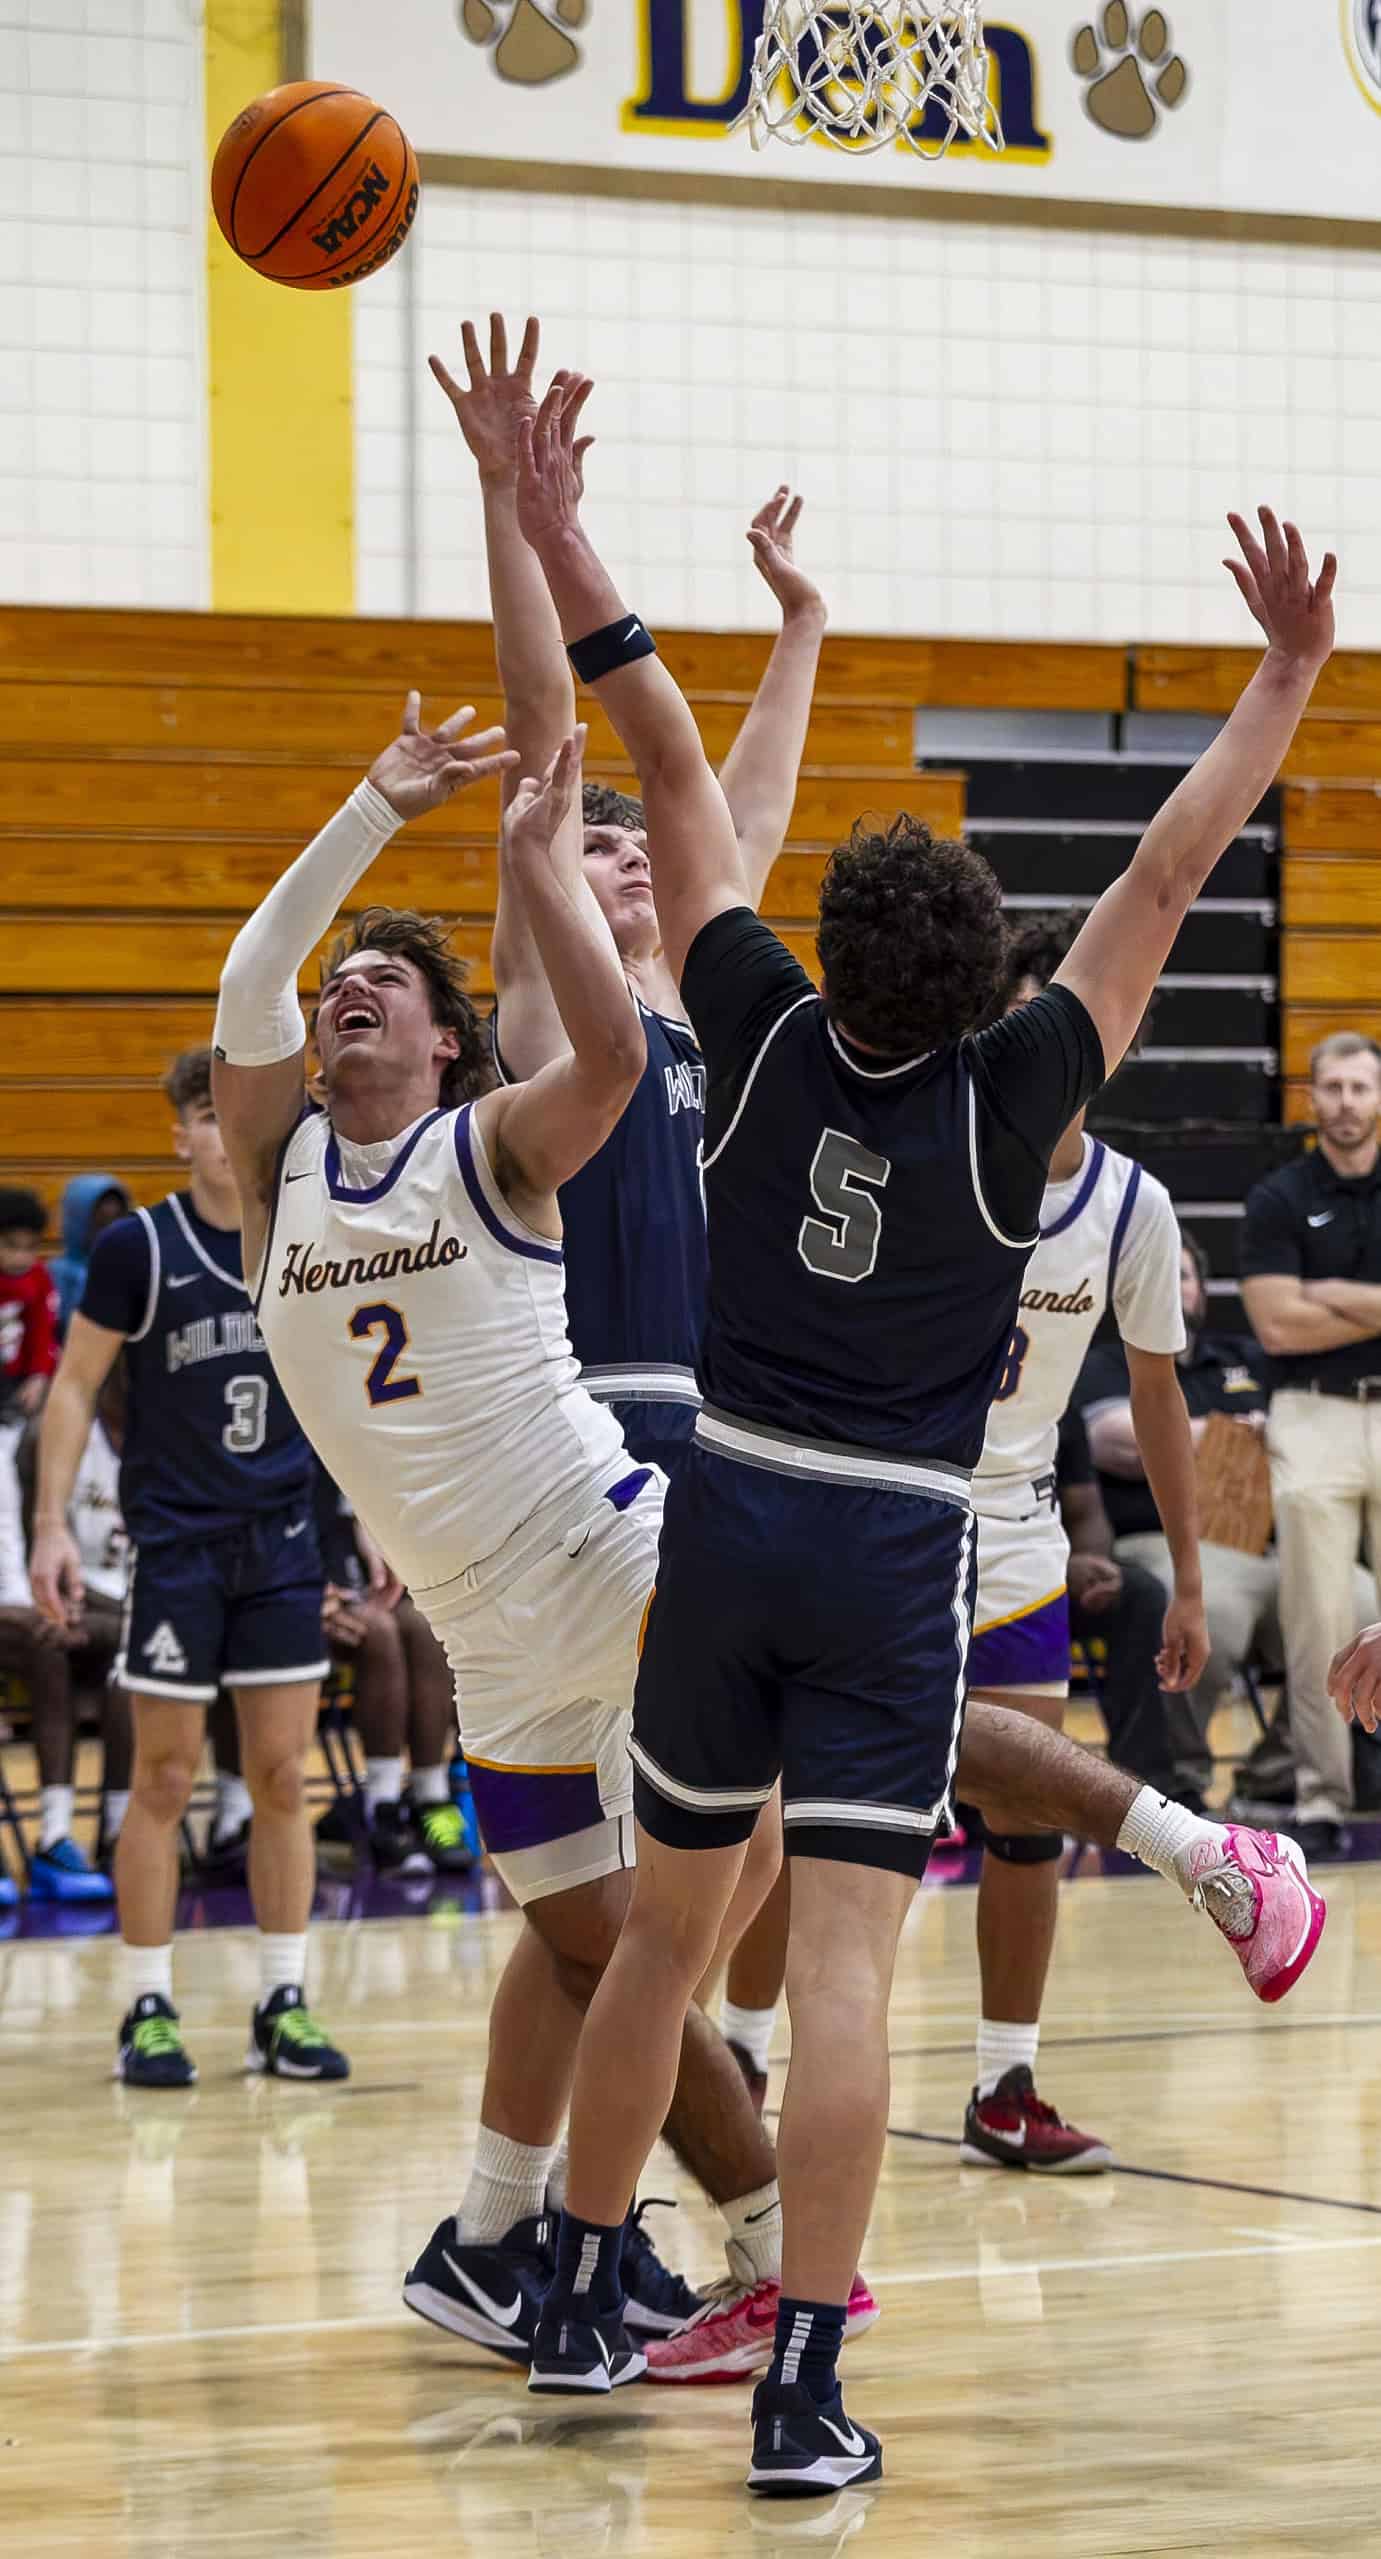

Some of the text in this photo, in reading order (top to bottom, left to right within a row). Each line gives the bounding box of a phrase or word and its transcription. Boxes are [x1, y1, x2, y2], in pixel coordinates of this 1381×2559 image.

[311, 160, 390, 255] NCAA
[797, 1127, 891, 1283] 5
[278, 1218, 468, 1297] Hernando
[348, 1300, 424, 1409] 2
[222, 1375, 269, 1453] 3
